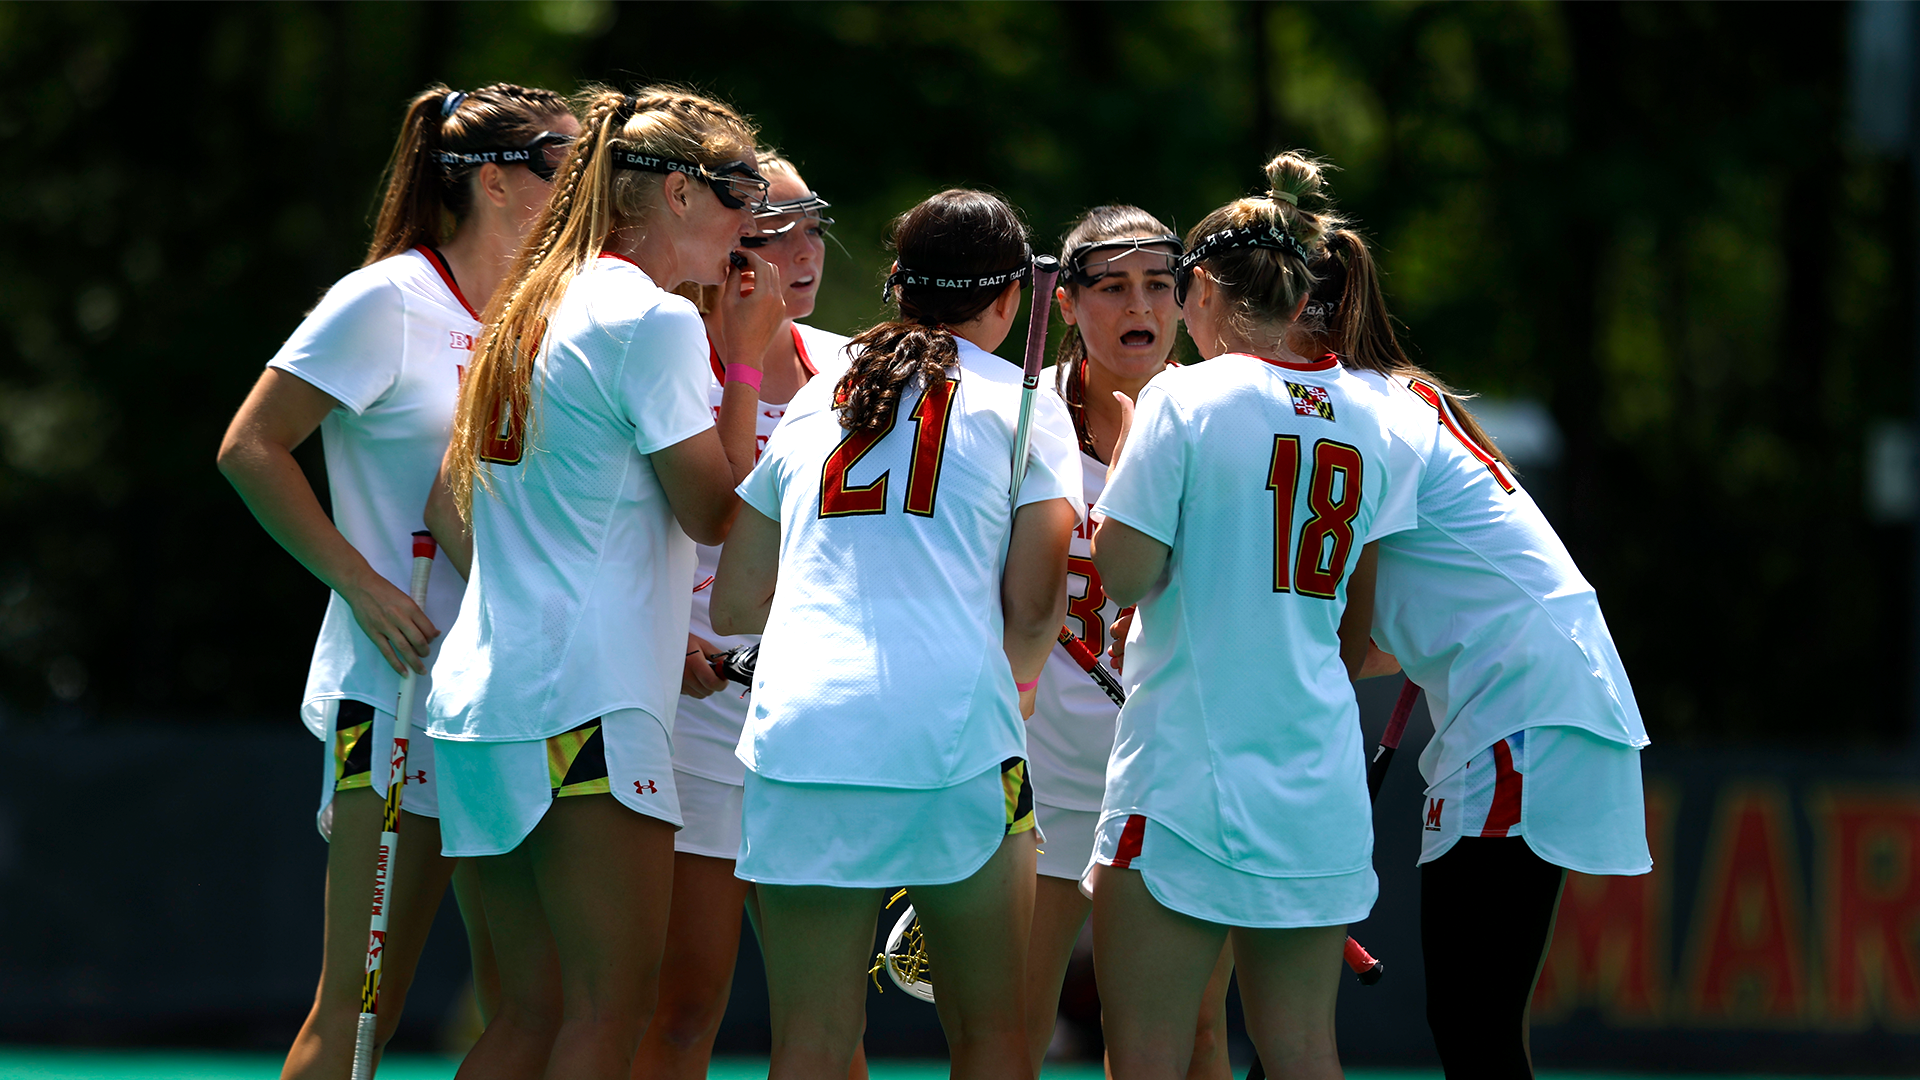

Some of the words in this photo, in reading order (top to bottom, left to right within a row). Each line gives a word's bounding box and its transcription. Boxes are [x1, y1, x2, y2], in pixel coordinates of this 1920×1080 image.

[463, 151, 498, 164] GAIT
[502, 149, 530, 161] GAI
[626, 153, 661, 168] GAIT
[666, 161, 702, 178] GAIT
[936, 278, 973, 289] GAIT
[978, 274, 1007, 287] GAIT
[1009, 266, 1027, 281] GAIT
[1182, 244, 1207, 267] GAIT
[818, 378, 961, 520] 21
[1265, 433, 1364, 601] 18
[1067, 554, 1137, 659] 3
[371, 845, 390, 917] MARYLAND
